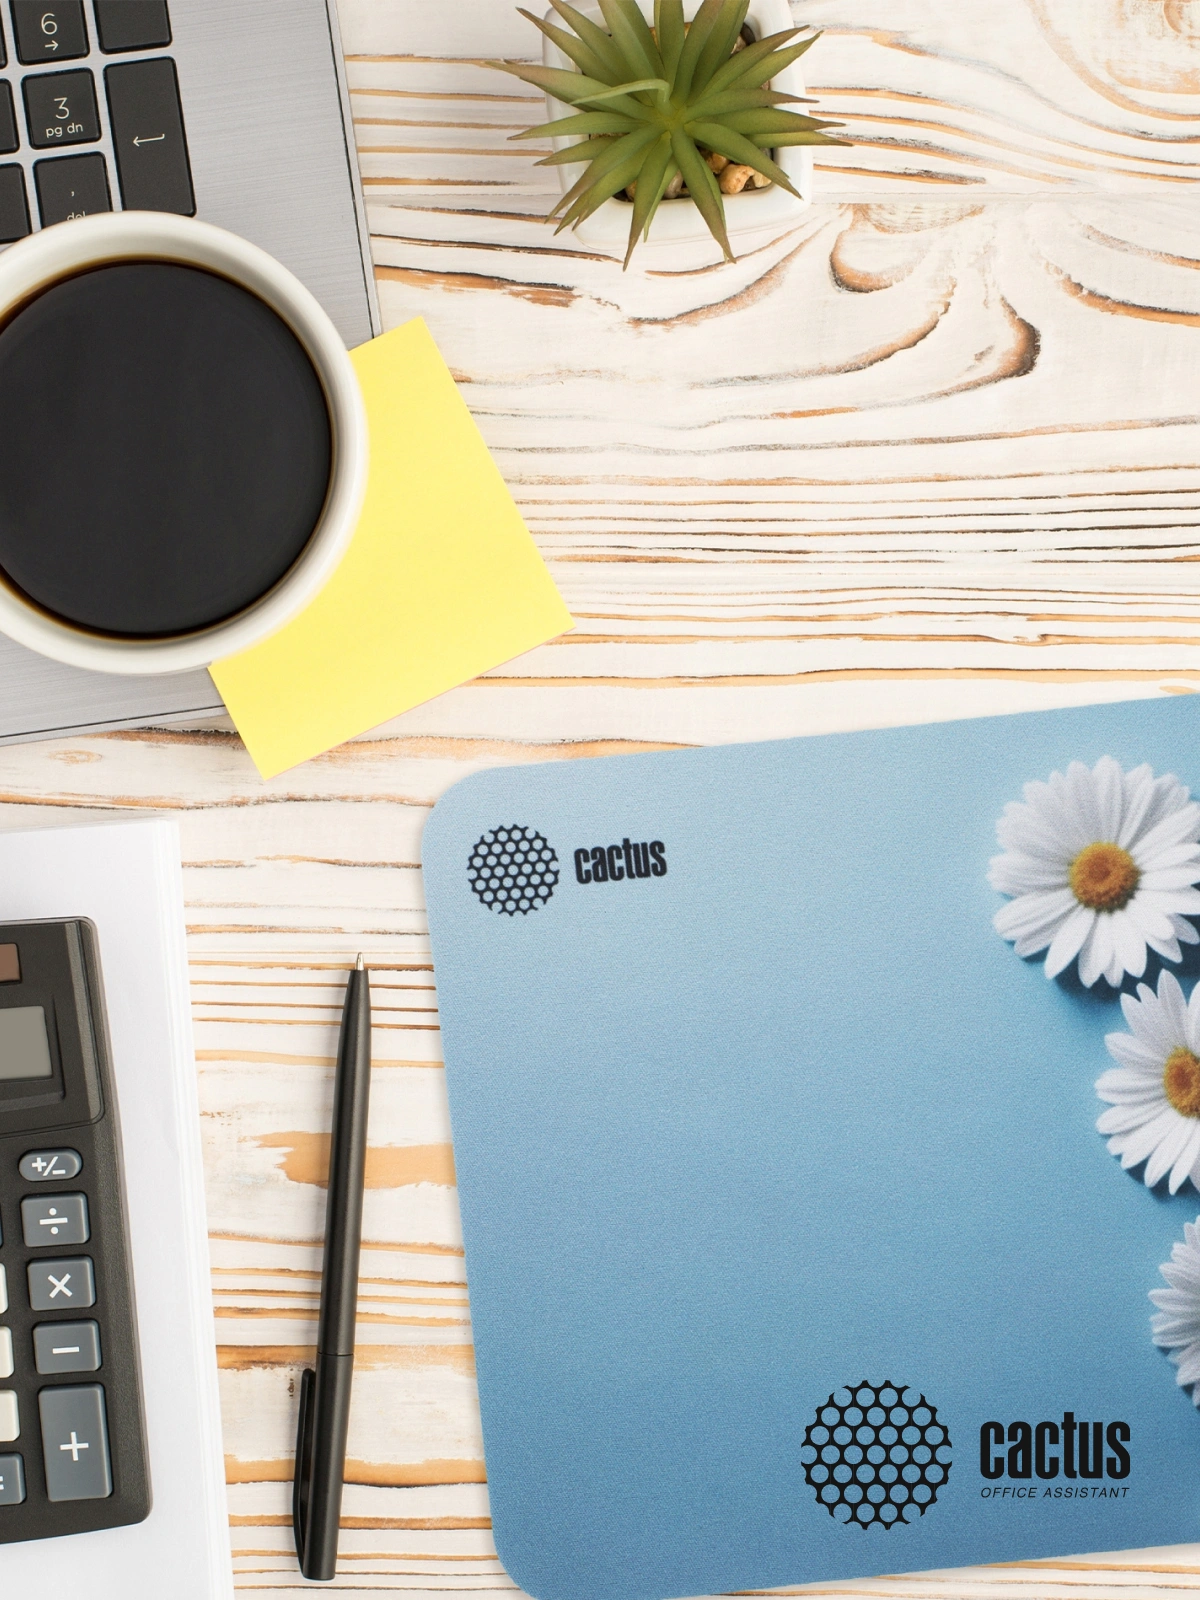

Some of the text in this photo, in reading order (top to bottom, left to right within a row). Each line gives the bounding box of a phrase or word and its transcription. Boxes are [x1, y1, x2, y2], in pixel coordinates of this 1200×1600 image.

[41, 13, 58, 35] 6
[53, 97, 70, 120] 3
[45, 122, 84, 138] pg dn
[574, 838, 668, 884] cactus
